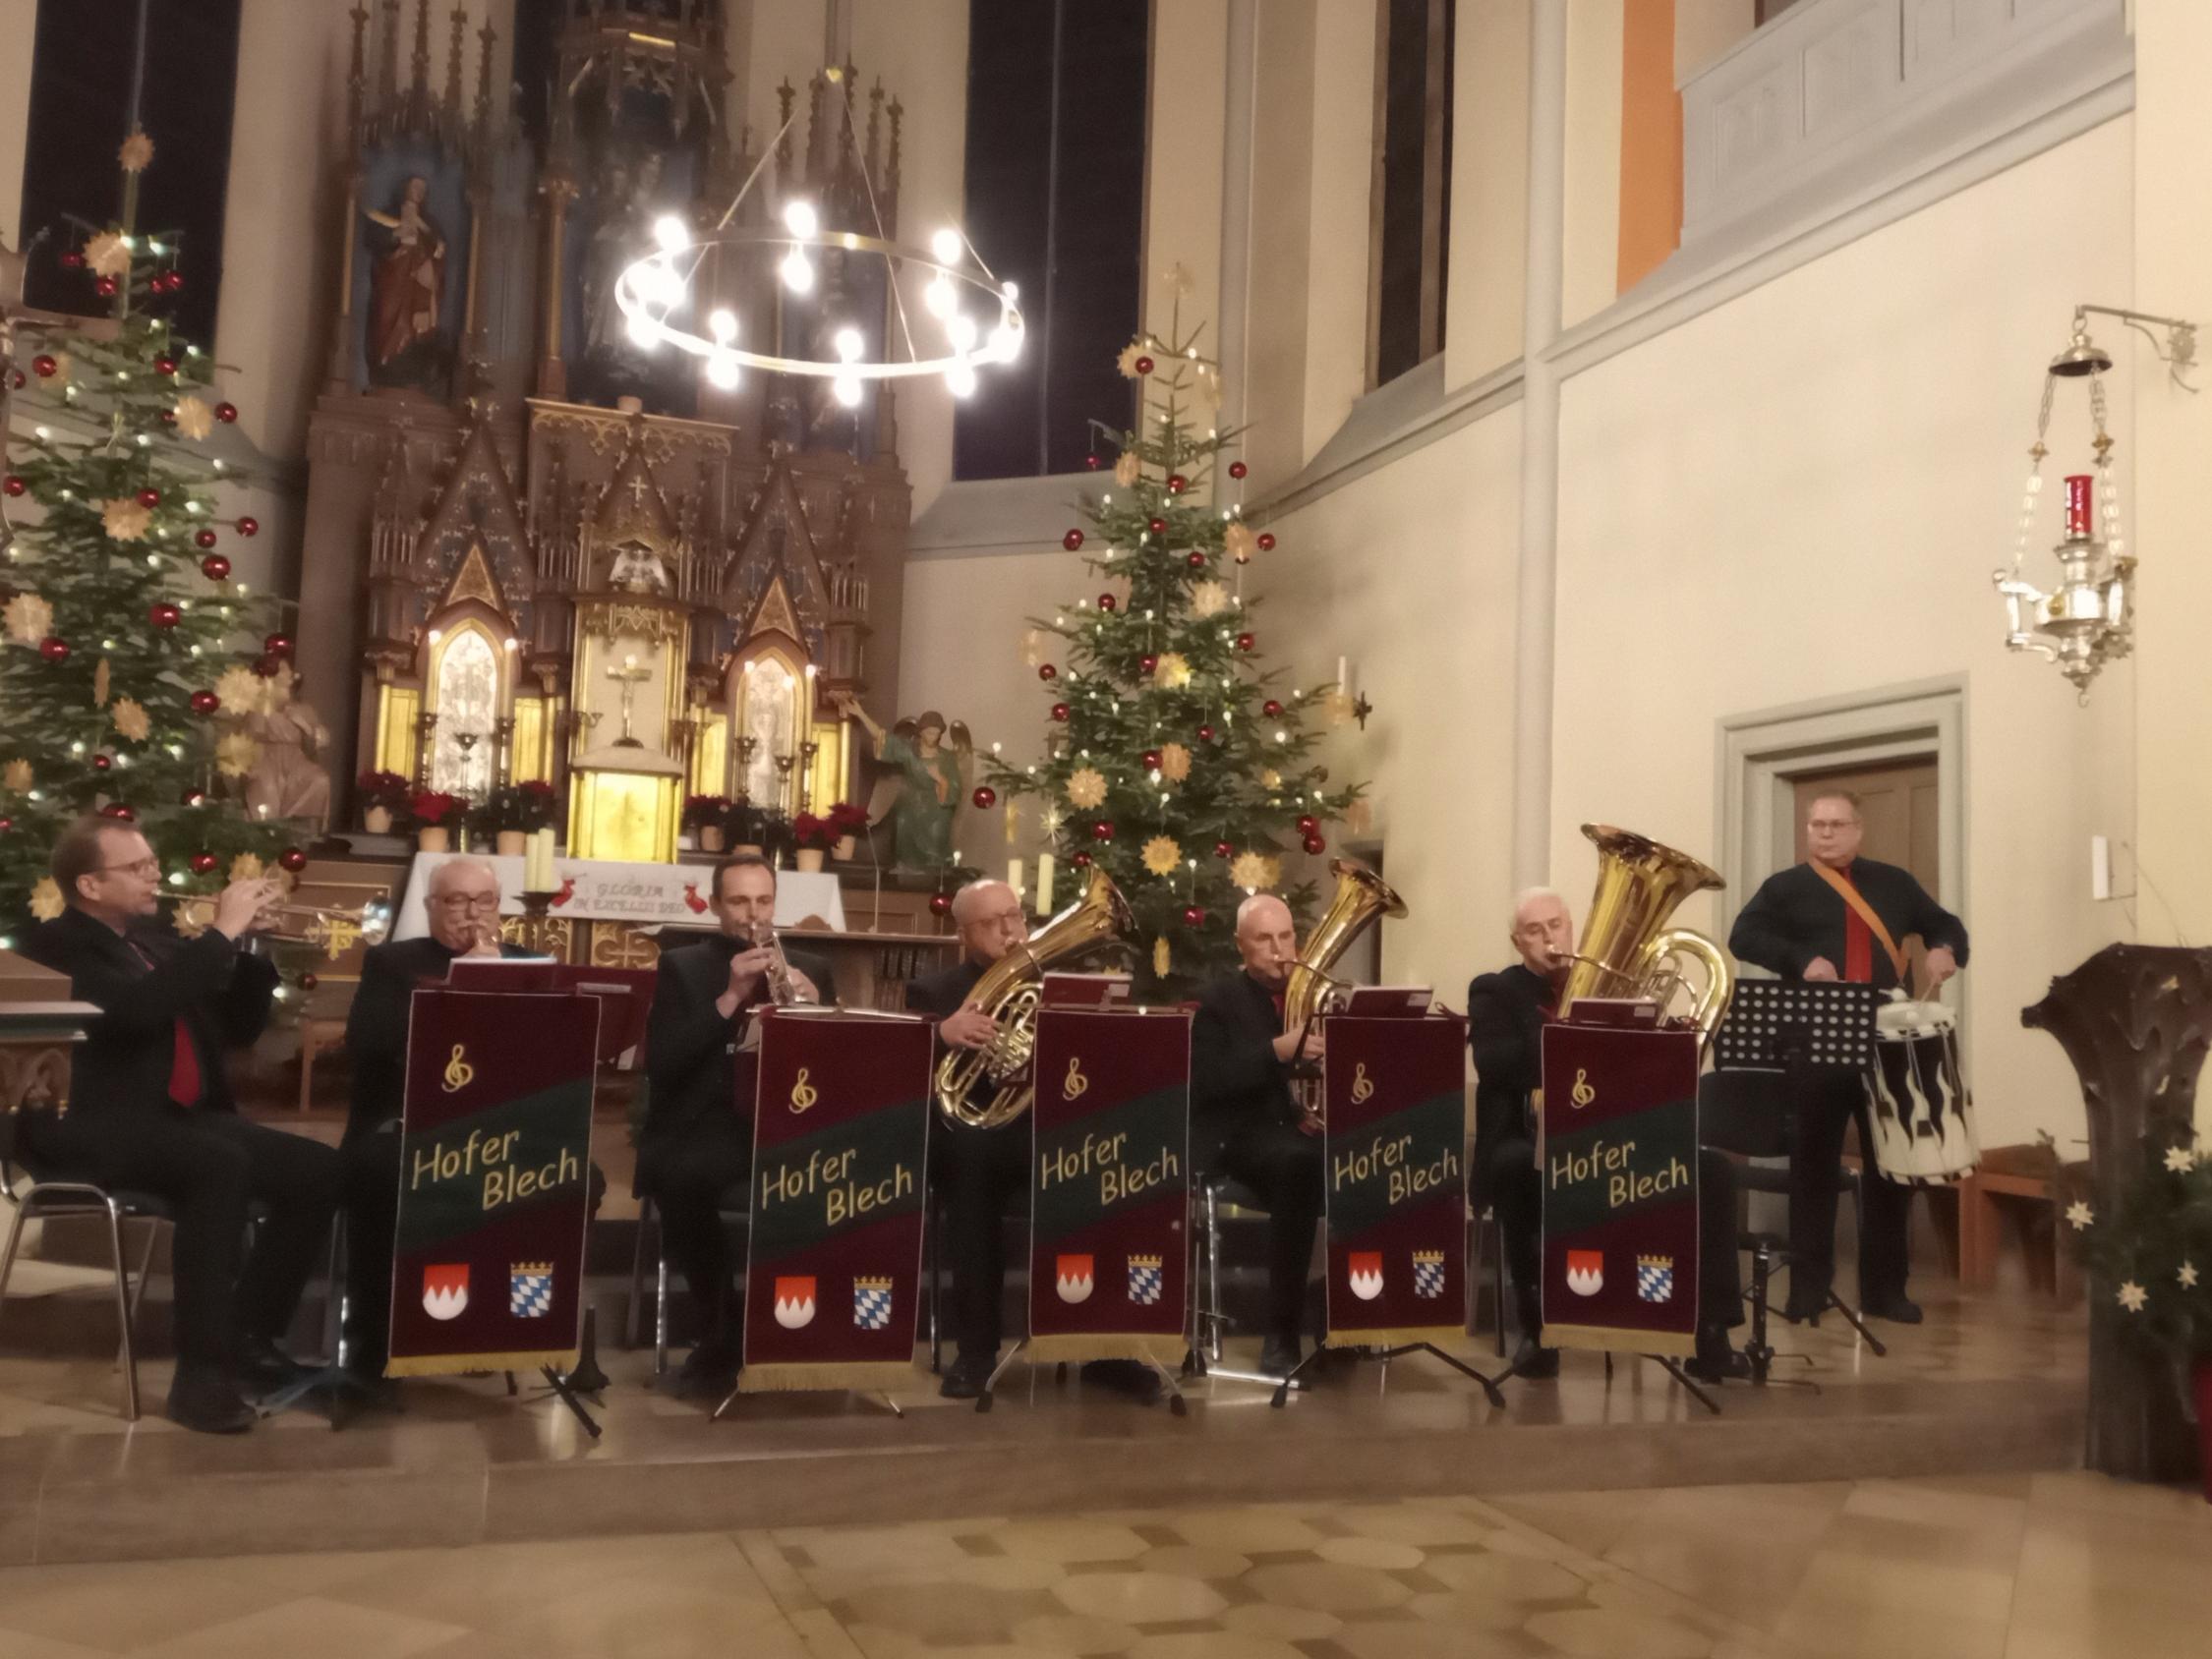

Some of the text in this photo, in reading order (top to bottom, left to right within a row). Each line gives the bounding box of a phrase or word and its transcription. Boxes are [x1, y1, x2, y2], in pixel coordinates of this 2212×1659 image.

[411, 1130, 520, 1189] Hofer
[482, 1147, 578, 1211] Blech
[762, 1148, 857, 1210] Hofer
[1041, 1131, 1128, 1189] Hofer
[1100, 1147, 1179, 1206] Blech
[1335, 1132, 1413, 1190] Hofer
[1389, 1148, 1458, 1204] Blech
[1552, 1138, 1637, 1189] Hofer
[1609, 1158, 1689, 1208] Blech
[827, 1163, 912, 1227] Blech
